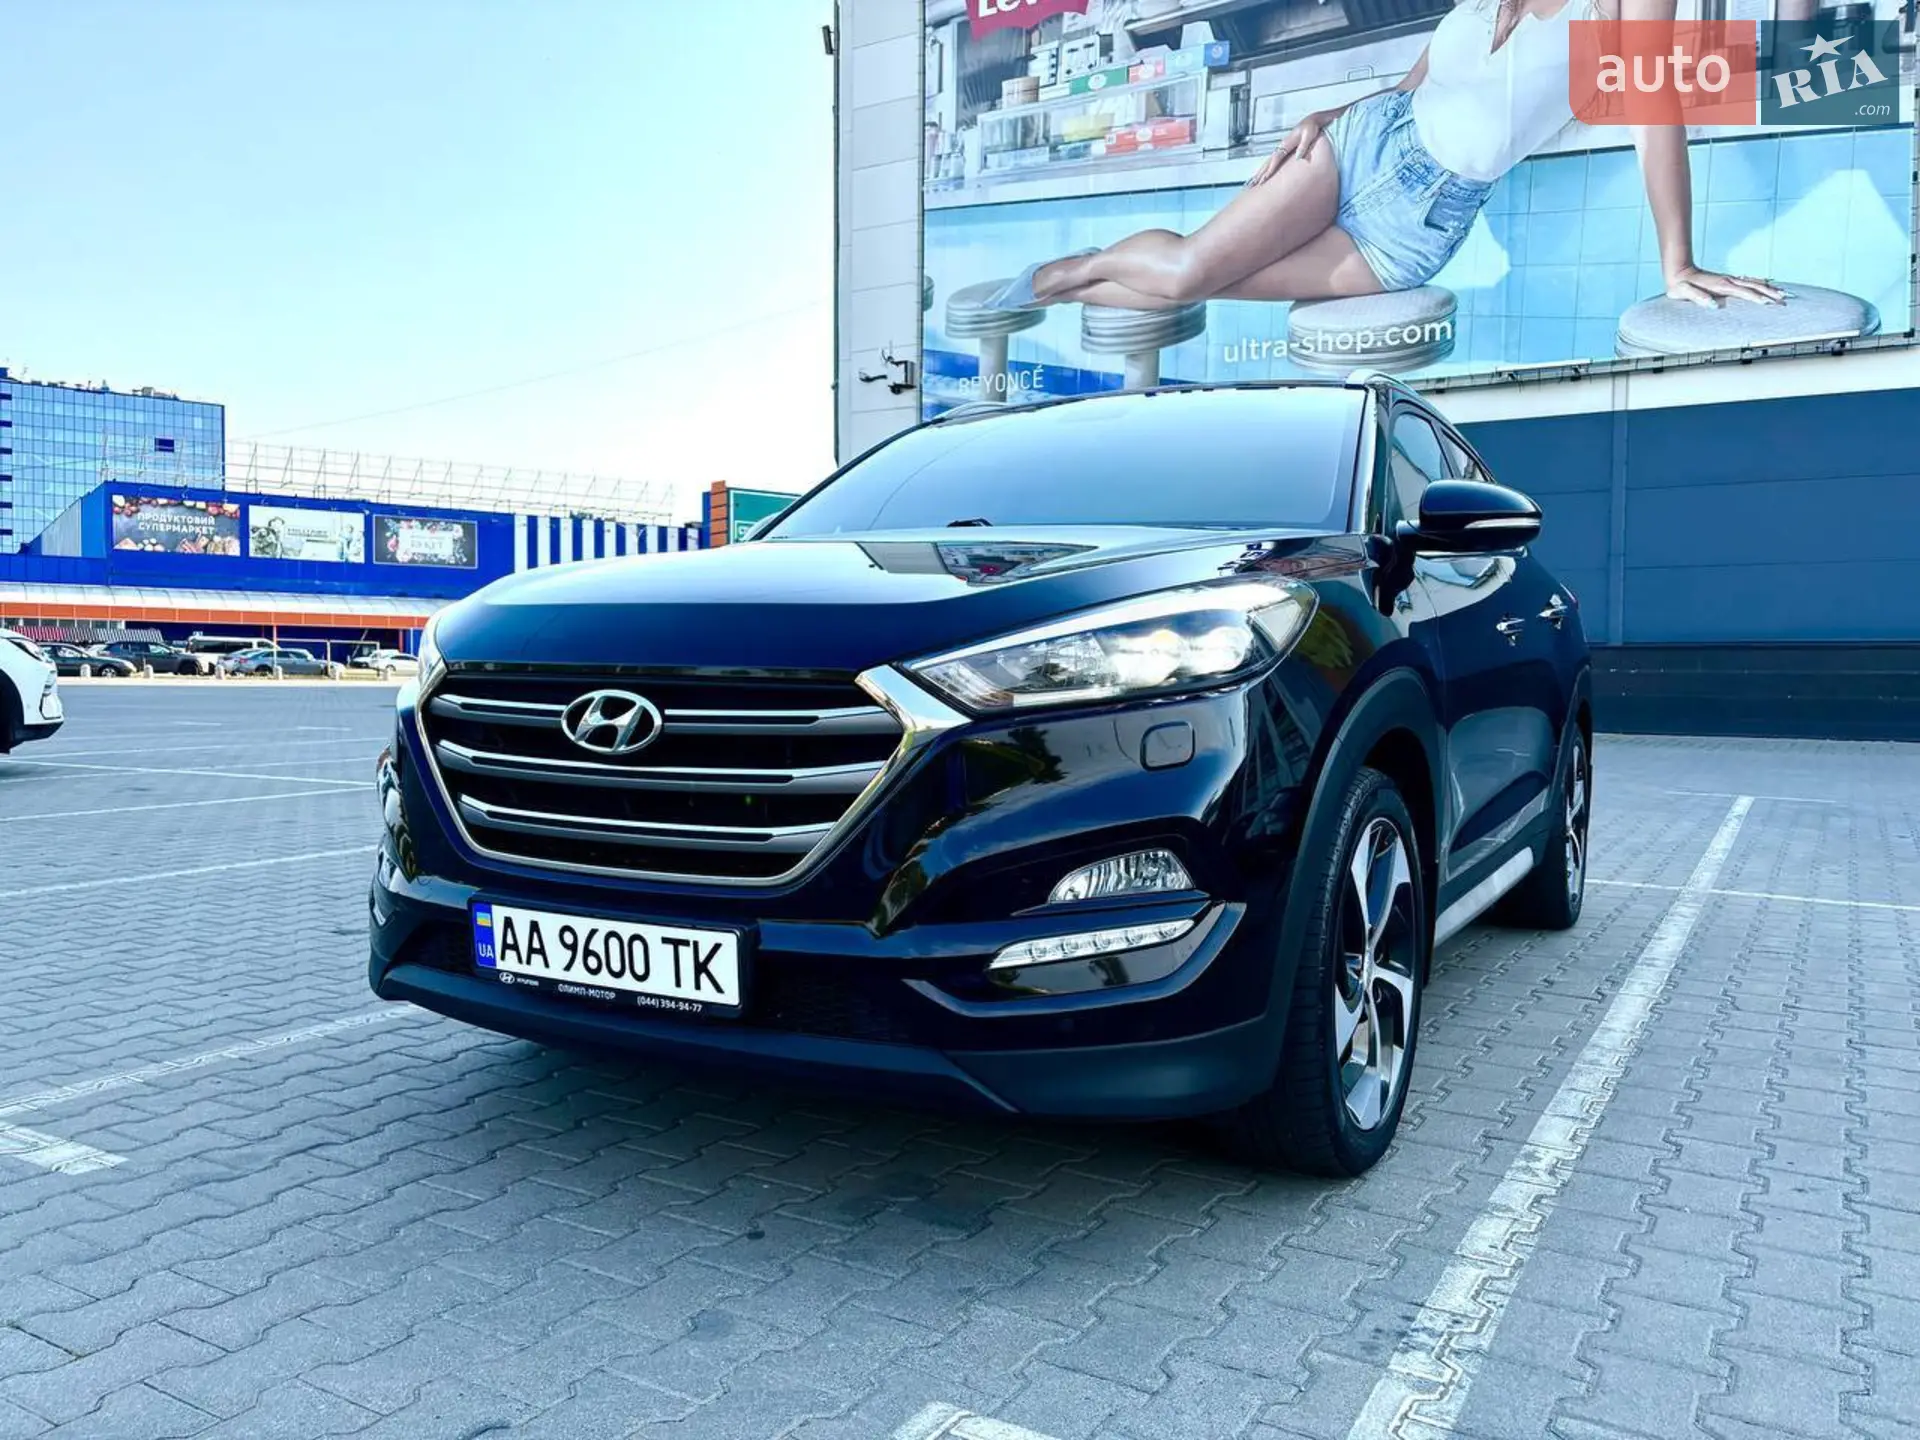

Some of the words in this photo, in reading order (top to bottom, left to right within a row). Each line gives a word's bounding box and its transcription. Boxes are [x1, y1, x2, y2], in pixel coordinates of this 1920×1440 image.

[1223, 320, 1452, 363] ultra-shop.com
[137, 512, 216, 525] ПРОДУКТОВИЙ
[137, 522, 216, 535] СУПЕРМАРКЕТ
[478, 942, 494, 958] UA
[500, 916, 550, 969] AA
[558, 924, 651, 983] 9600
[661, 936, 725, 994] TK
